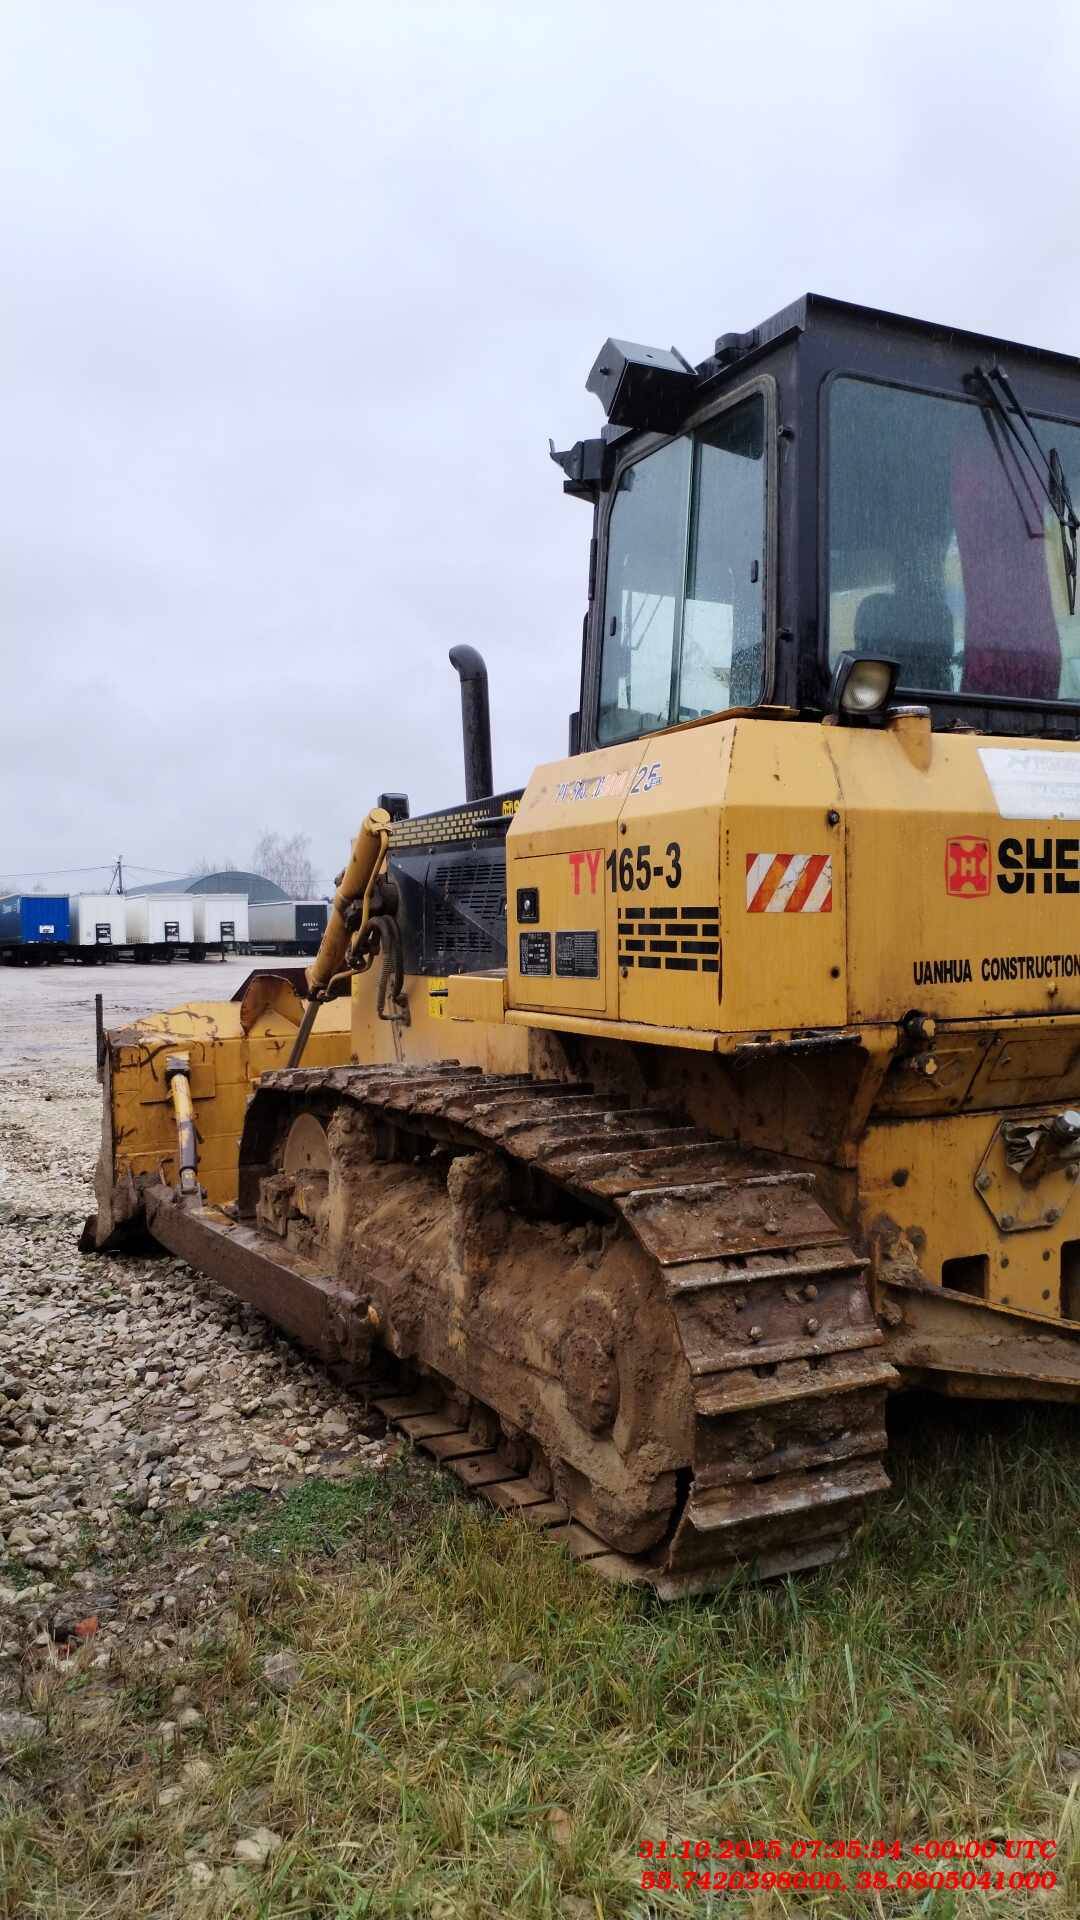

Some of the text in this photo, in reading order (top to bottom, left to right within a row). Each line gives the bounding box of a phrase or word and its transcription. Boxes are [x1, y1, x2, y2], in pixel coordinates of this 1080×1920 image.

[630, 763, 662, 794] 25
[913, 954, 1080, 985] UANHUA CONSTRUCTION
